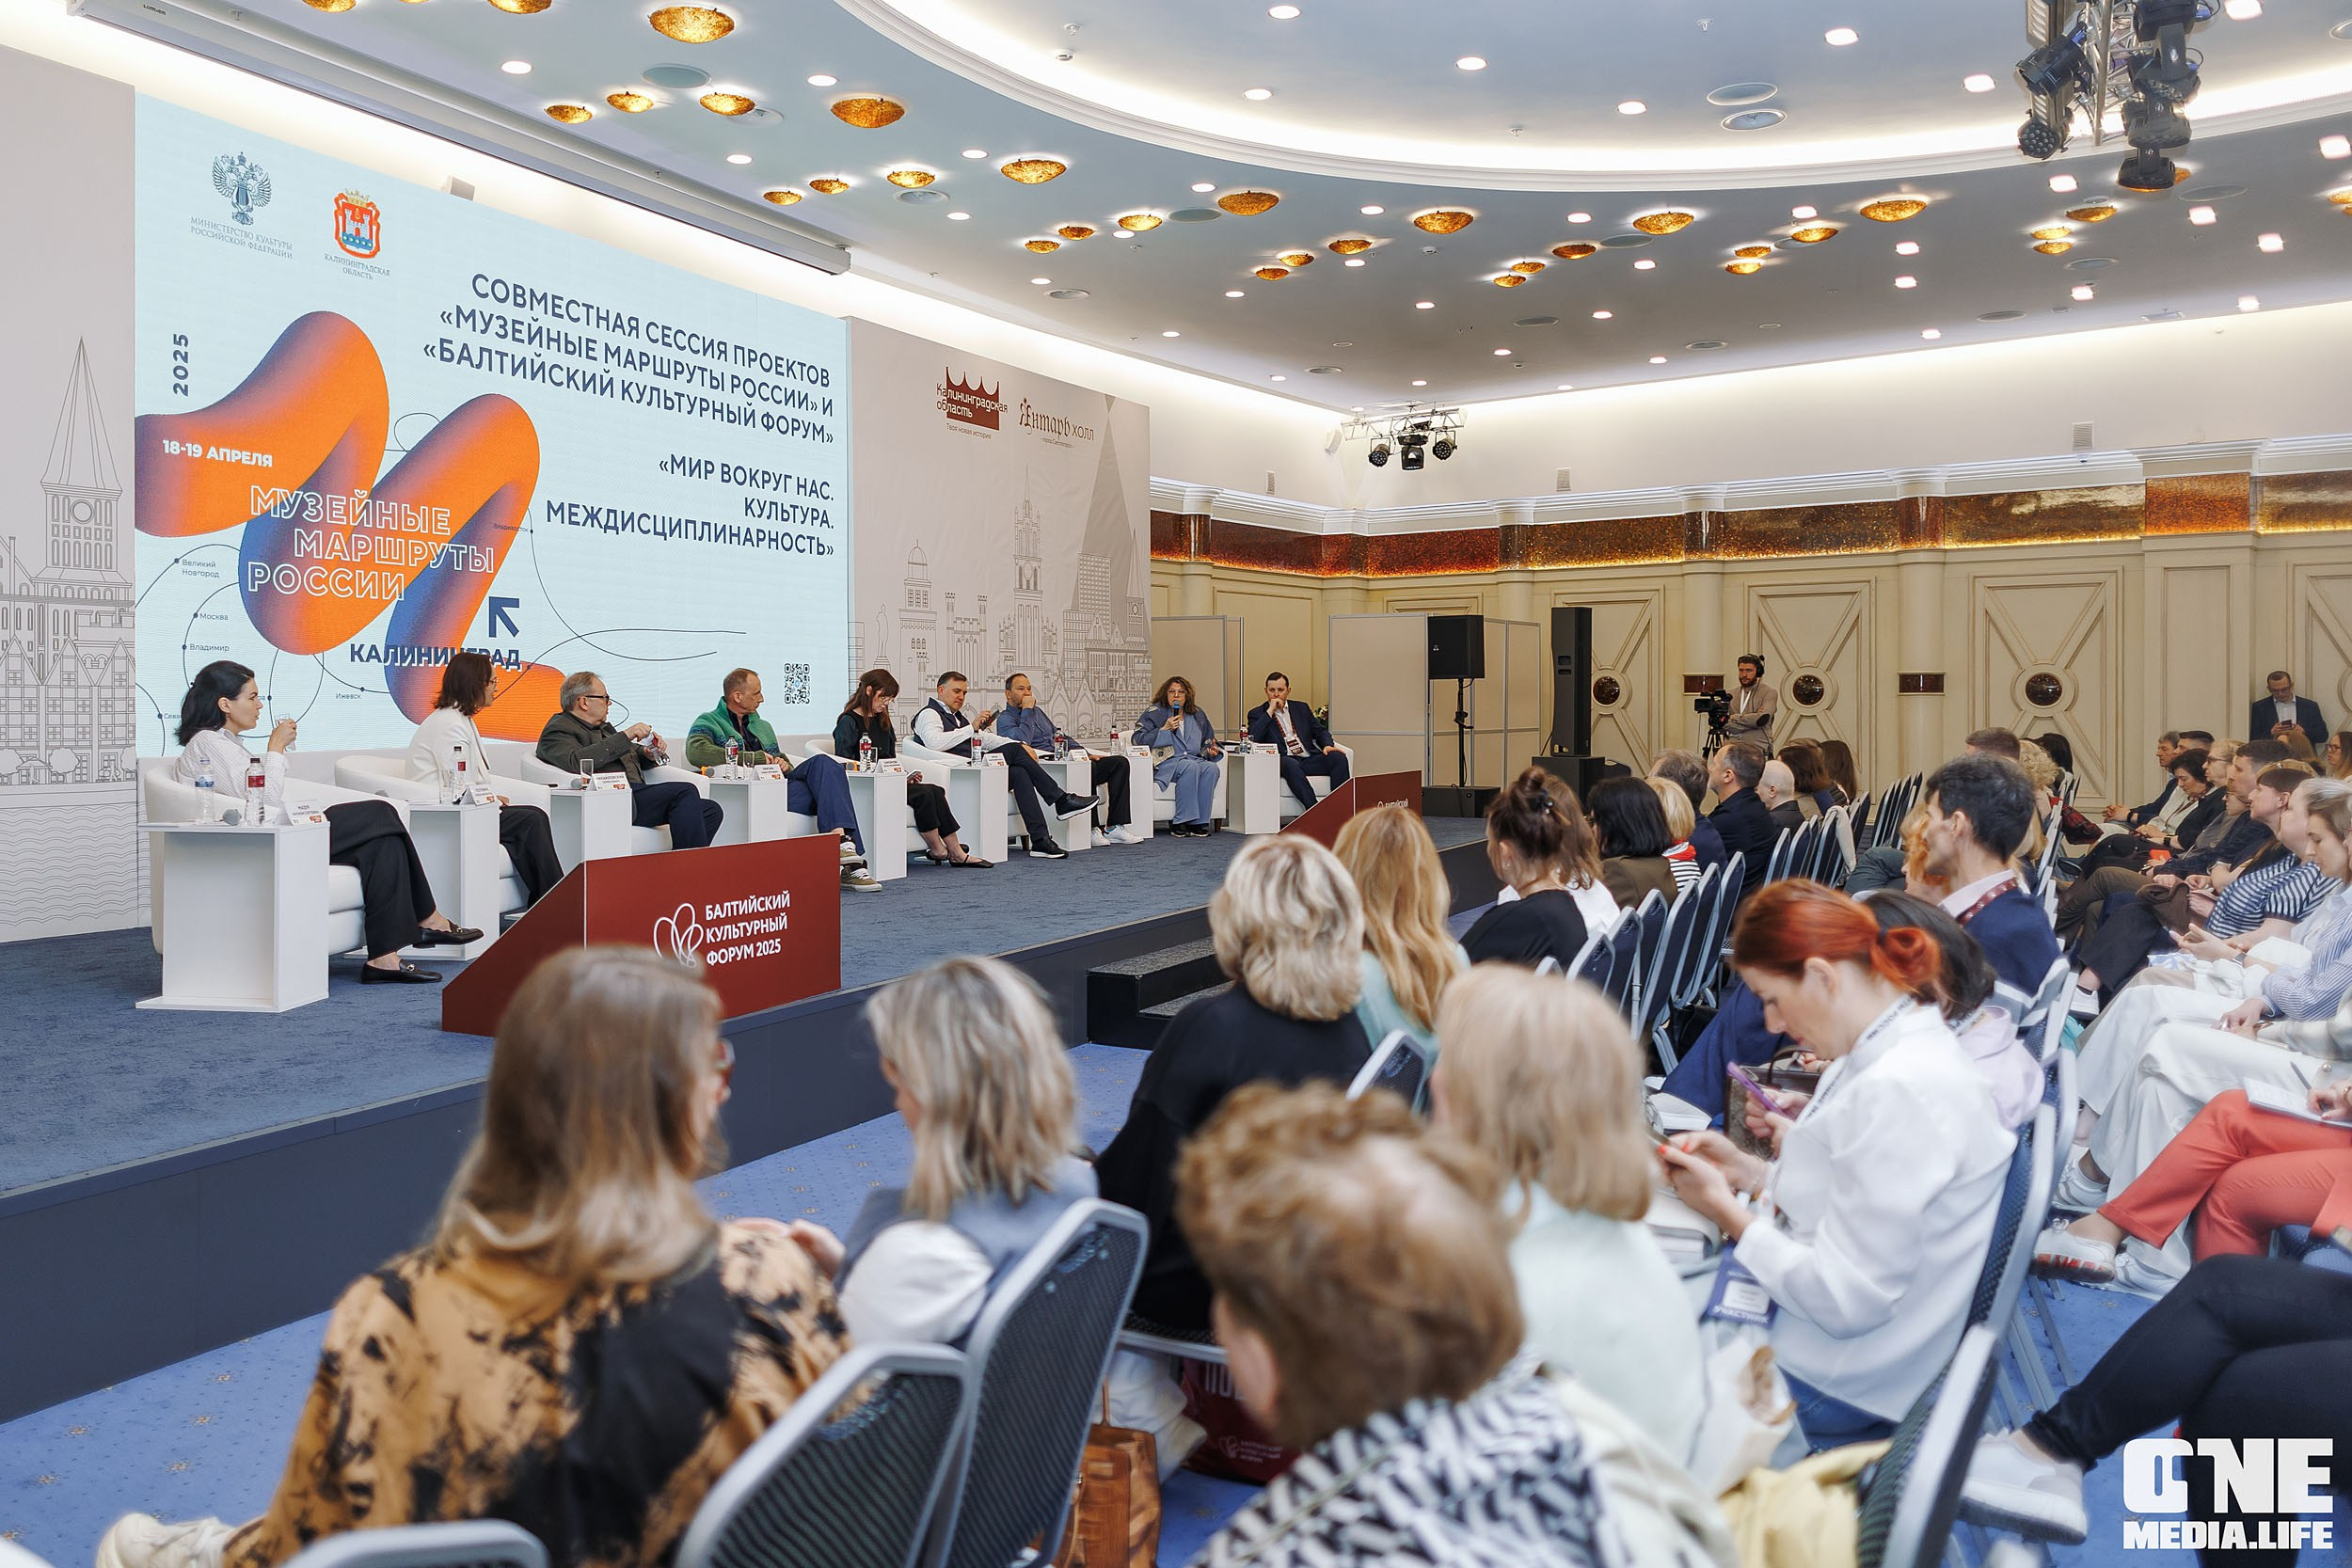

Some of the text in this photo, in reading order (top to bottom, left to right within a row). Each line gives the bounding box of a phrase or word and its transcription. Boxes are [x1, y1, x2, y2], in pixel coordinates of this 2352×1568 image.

[190, 216, 293, 251] МИНИСТЕРСТВО КУЛЬТУРЫ
[190, 226, 293, 260] РОССИЙСКОЙ ФЕДЕРАЦИИ
[324, 253, 390, 277] КАЛИНИНГРАДСКАЯ
[342, 267, 373, 280] ОБЛАСТЬ
[471, 273, 830, 388] СОВМЕСТНАЯ СЕССИЯ ПРОЕКТОВ
[172, 333, 189, 397] 2025
[439, 305, 834, 418] «МУЗЕЙНЫЕ МАРШРУТЫ РОССИИ» И
[423, 338, 834, 444] «БАЛТИЙСКИЙ КУЛЬТУРНЫЙ ФОРУМ»
[936, 383, 1009, 414] Калининградская
[936, 399, 973, 419] область
[1072, 422, 1094, 441] холл
[162, 439, 274, 467] 18-19 АПРЕЛЯ
[659, 453, 834, 501] «МИР ВОКРУГ НАС.
[250, 484, 452, 536] МУЗЕЙНЫЕ
[744, 497, 834, 530] КУЛЬТУРА.
[546, 499, 834, 556] МЕЖДИСЦИПЛИНАРНОСТЬ»
[182, 559, 216, 568] Великий
[294, 528, 495, 574] МАРШРУТЫ
[182, 568, 220, 578] Новгород
[247, 561, 405, 601] РОССИИ
[199, 612, 229, 621] Москва
[189, 643, 230, 652] Владимир
[350, 643, 522, 671] КАЛИНИАД
[706, 890, 790, 921] БАЛТИЙСКИЙ
[706, 912, 787, 943] КУЛЬТУРНЫЙ
[707, 938, 782, 967] ФОРУМ 2025
